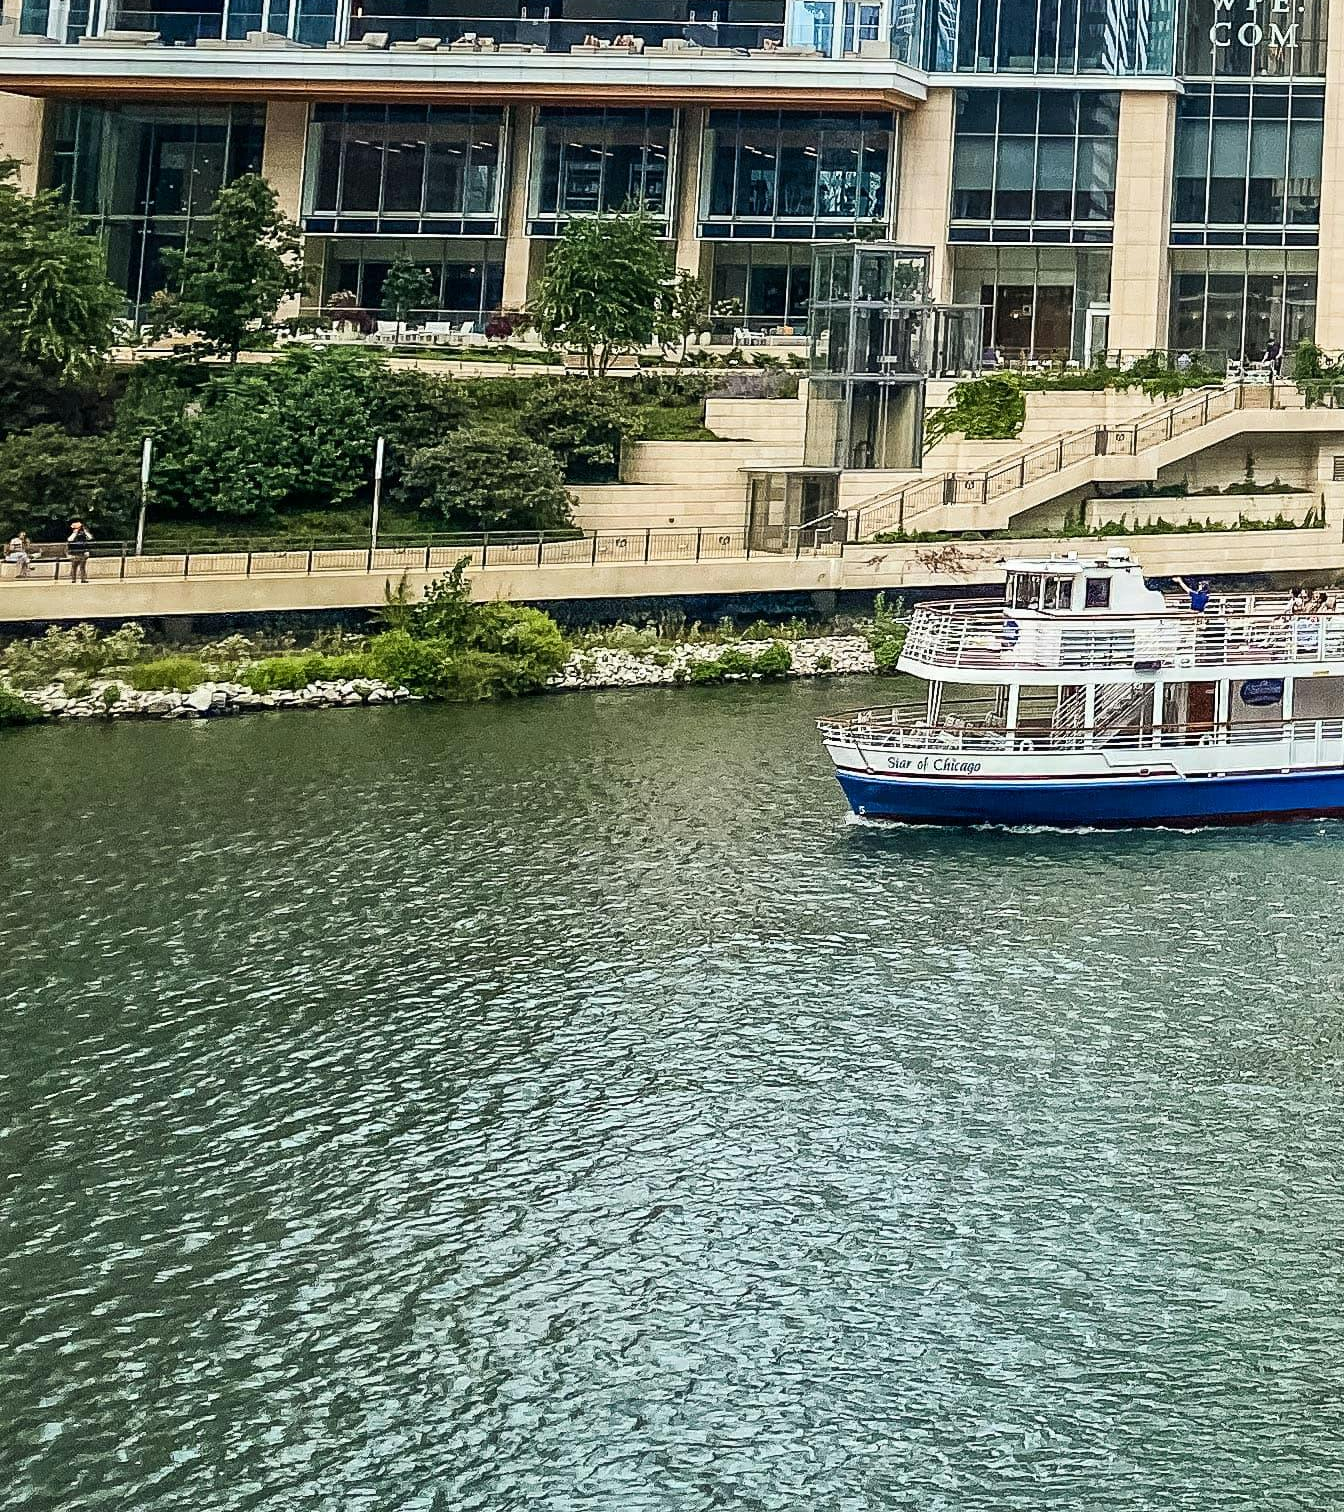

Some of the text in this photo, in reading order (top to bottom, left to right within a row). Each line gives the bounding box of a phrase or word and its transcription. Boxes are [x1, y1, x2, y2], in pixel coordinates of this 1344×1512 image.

[1209, 21, 1300, 48] COM
[887, 756, 982, 775] Star of Chicago
